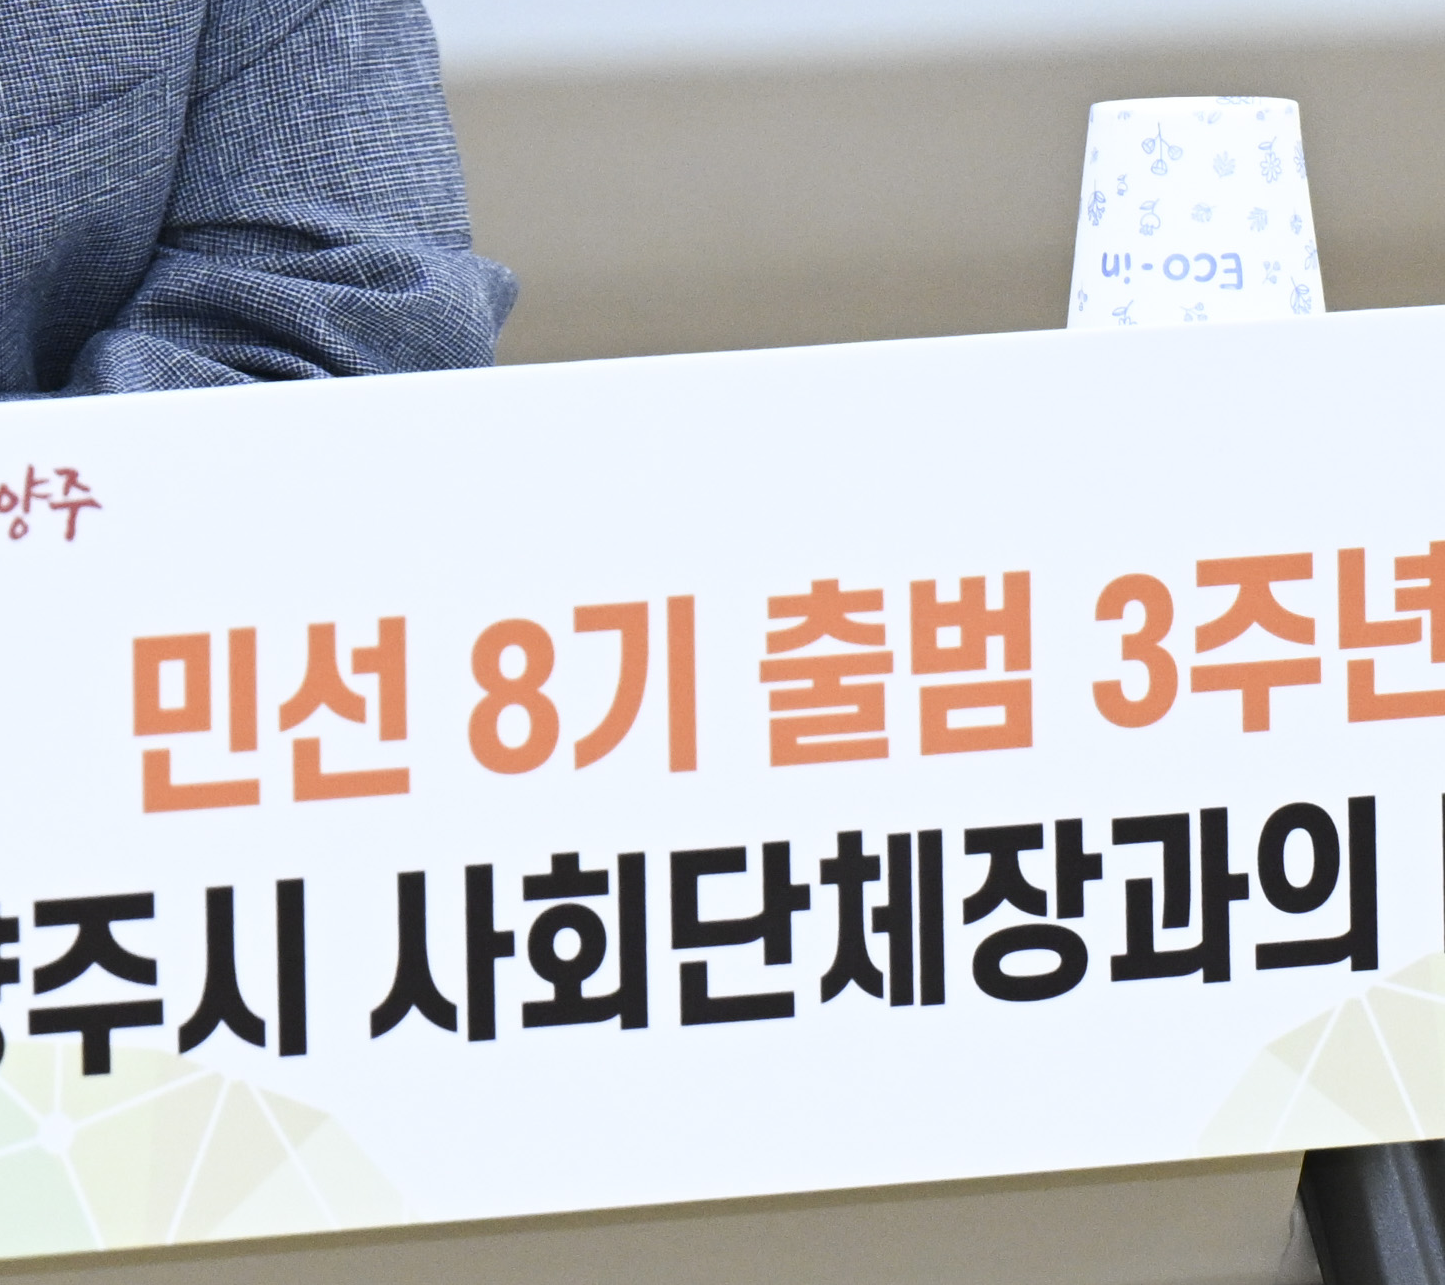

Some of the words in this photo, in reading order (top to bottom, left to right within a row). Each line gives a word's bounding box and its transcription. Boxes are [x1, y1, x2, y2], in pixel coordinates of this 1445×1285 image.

[132, 616, 410, 813] 민선
[468, 595, 697, 774] 8기
[760, 570, 1032, 767] 출범
[370, 795, 1379, 1042] 사회단체장과의
